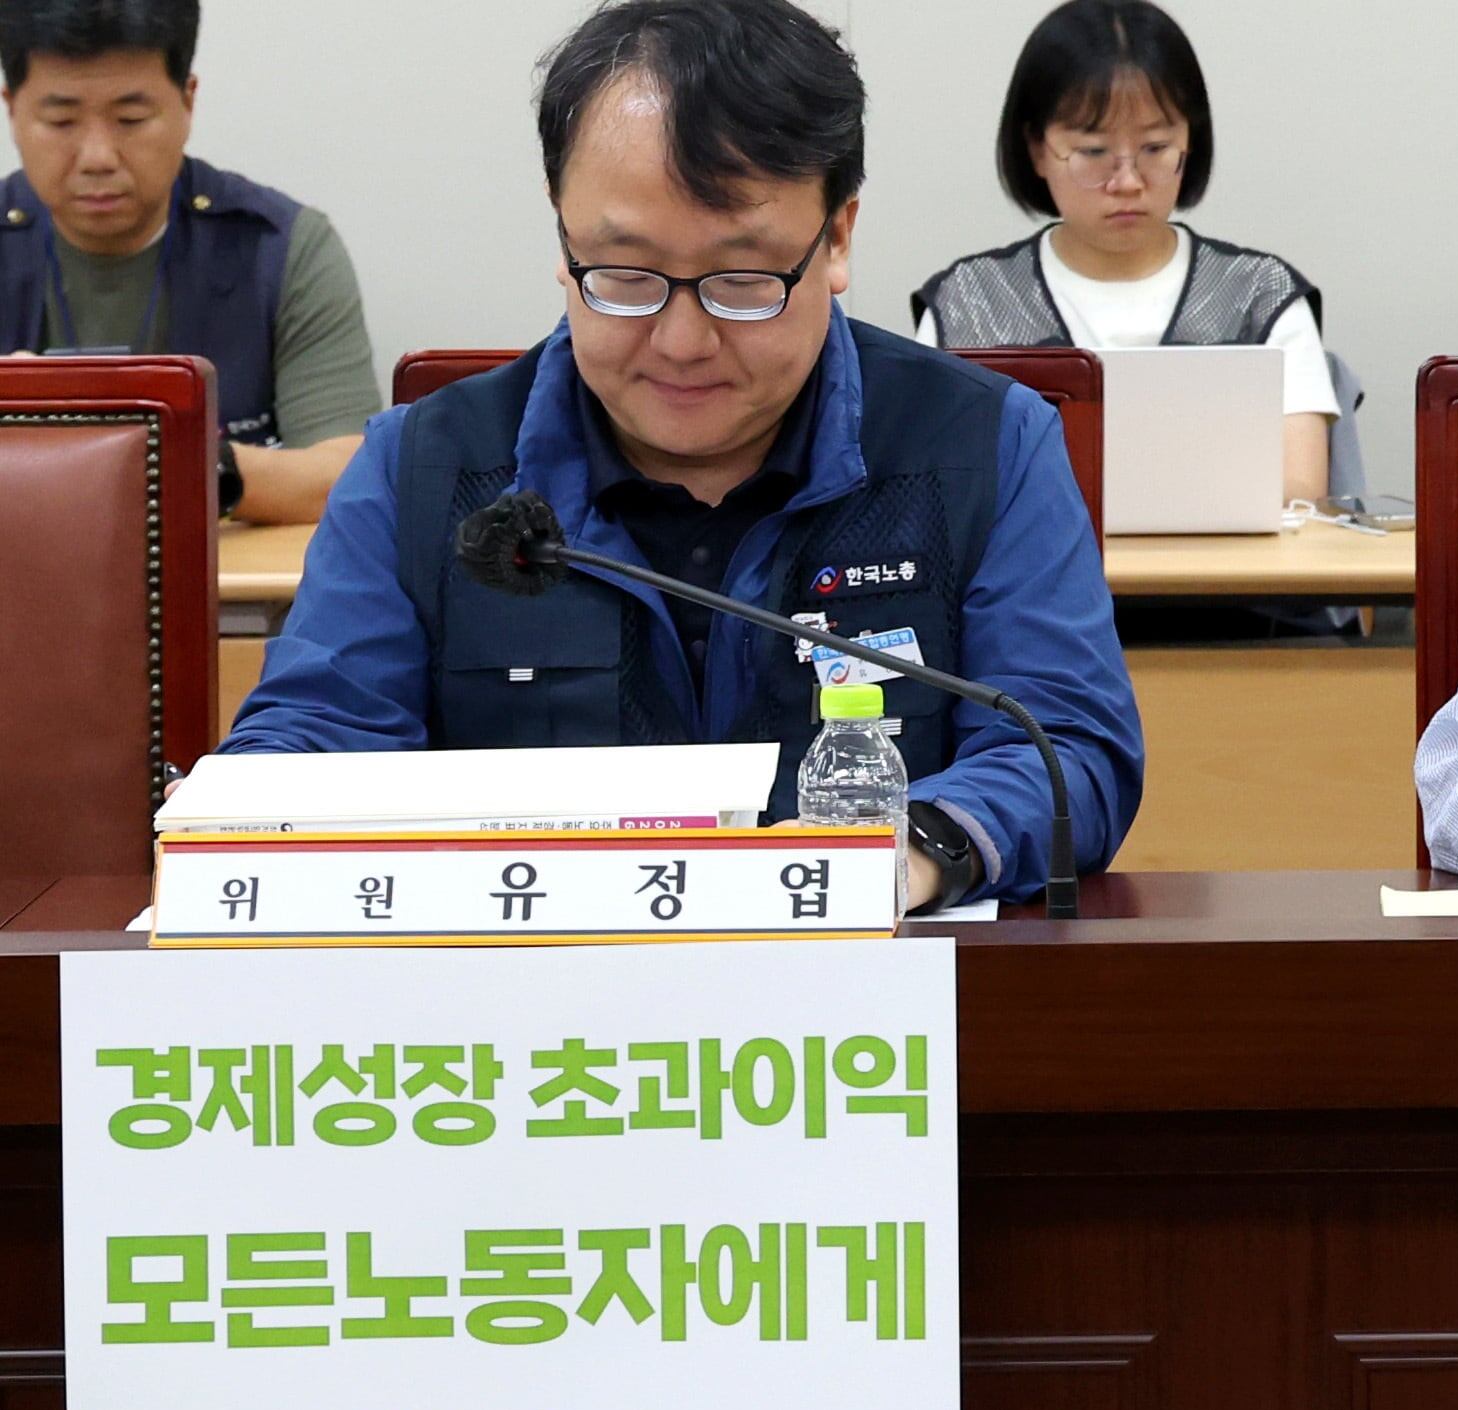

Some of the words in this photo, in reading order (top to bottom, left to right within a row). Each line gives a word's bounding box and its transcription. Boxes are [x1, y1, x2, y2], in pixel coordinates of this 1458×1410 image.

[845, 561, 917, 586] 한국노총
[95, 1043, 505, 1151] 경제성장
[525, 1034, 929, 1141] 초과이익
[100, 1221, 928, 1349] 모든노동자에게
